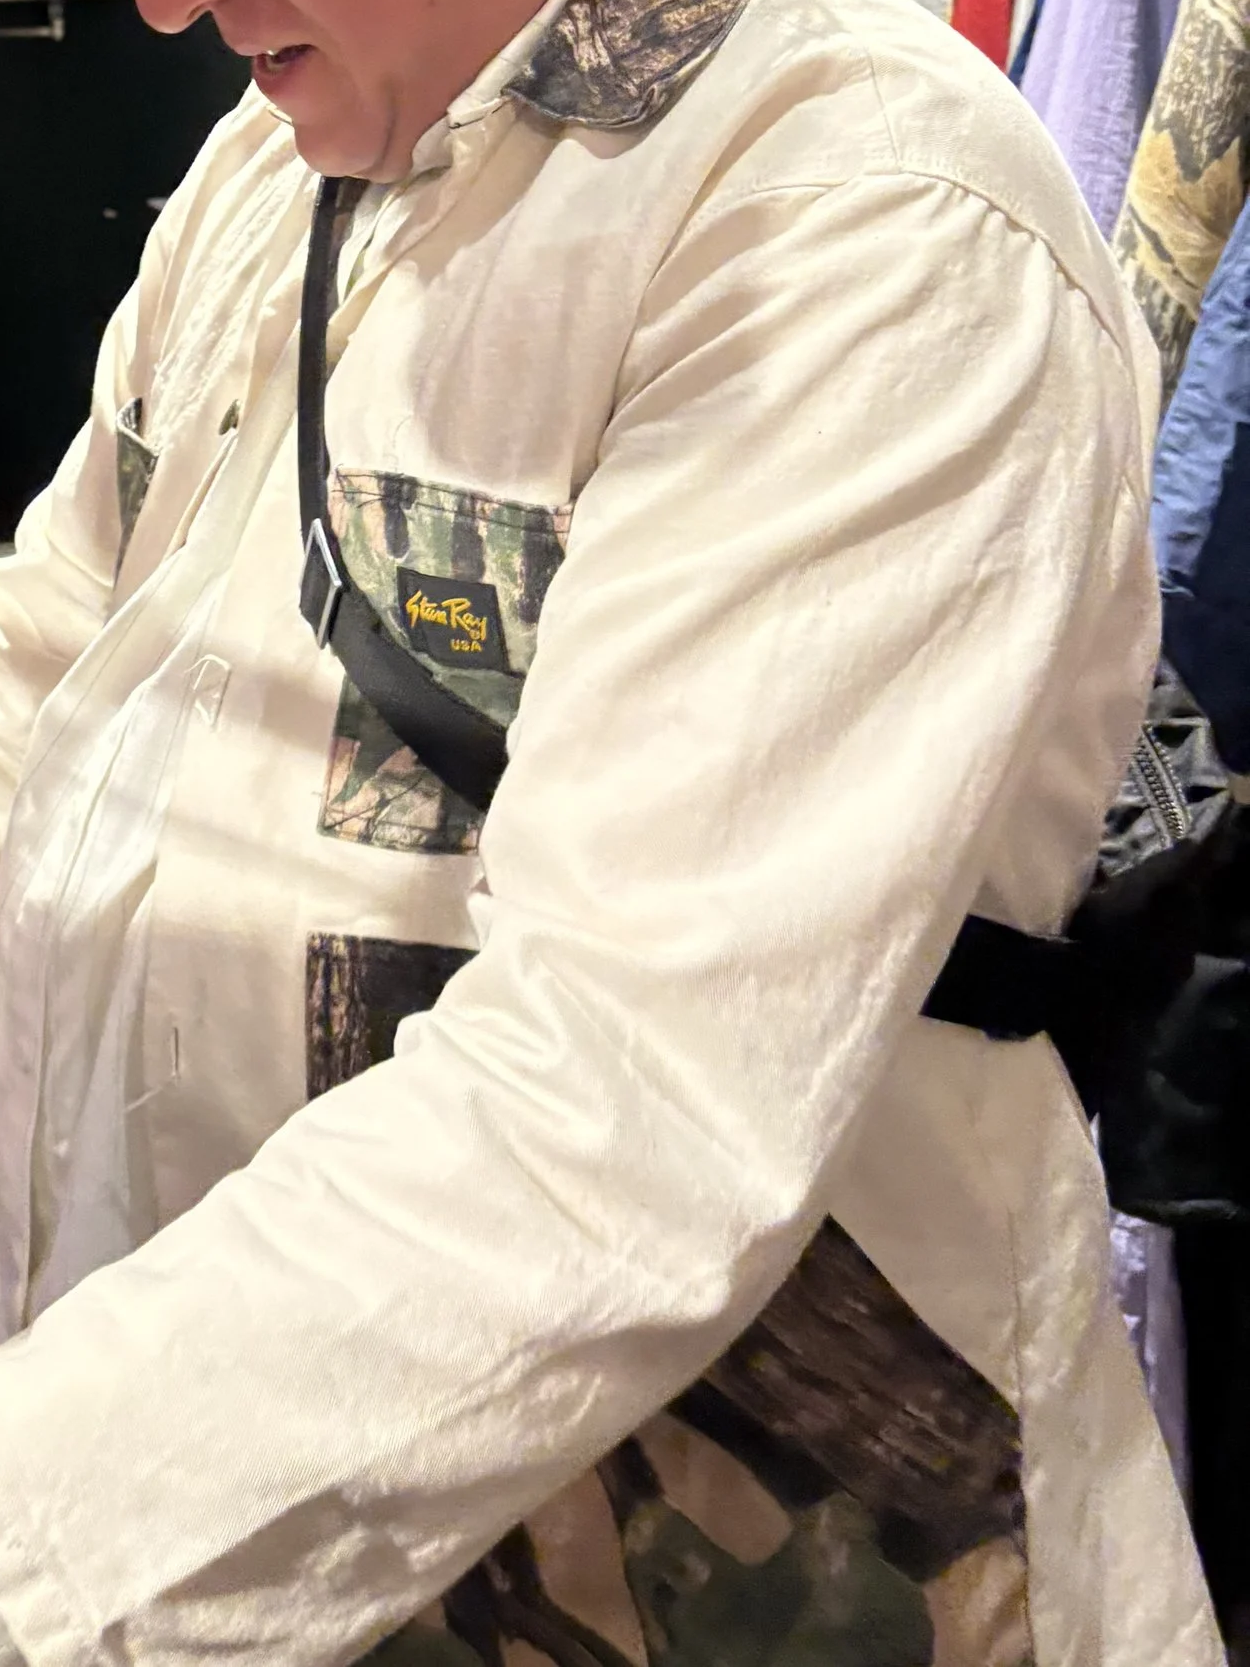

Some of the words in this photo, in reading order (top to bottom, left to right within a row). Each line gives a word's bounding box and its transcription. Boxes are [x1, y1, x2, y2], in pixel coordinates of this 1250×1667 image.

[405, 590, 448, 629] Stan
[441, 597, 487, 641] Ray
[451, 638, 482, 652] USA
